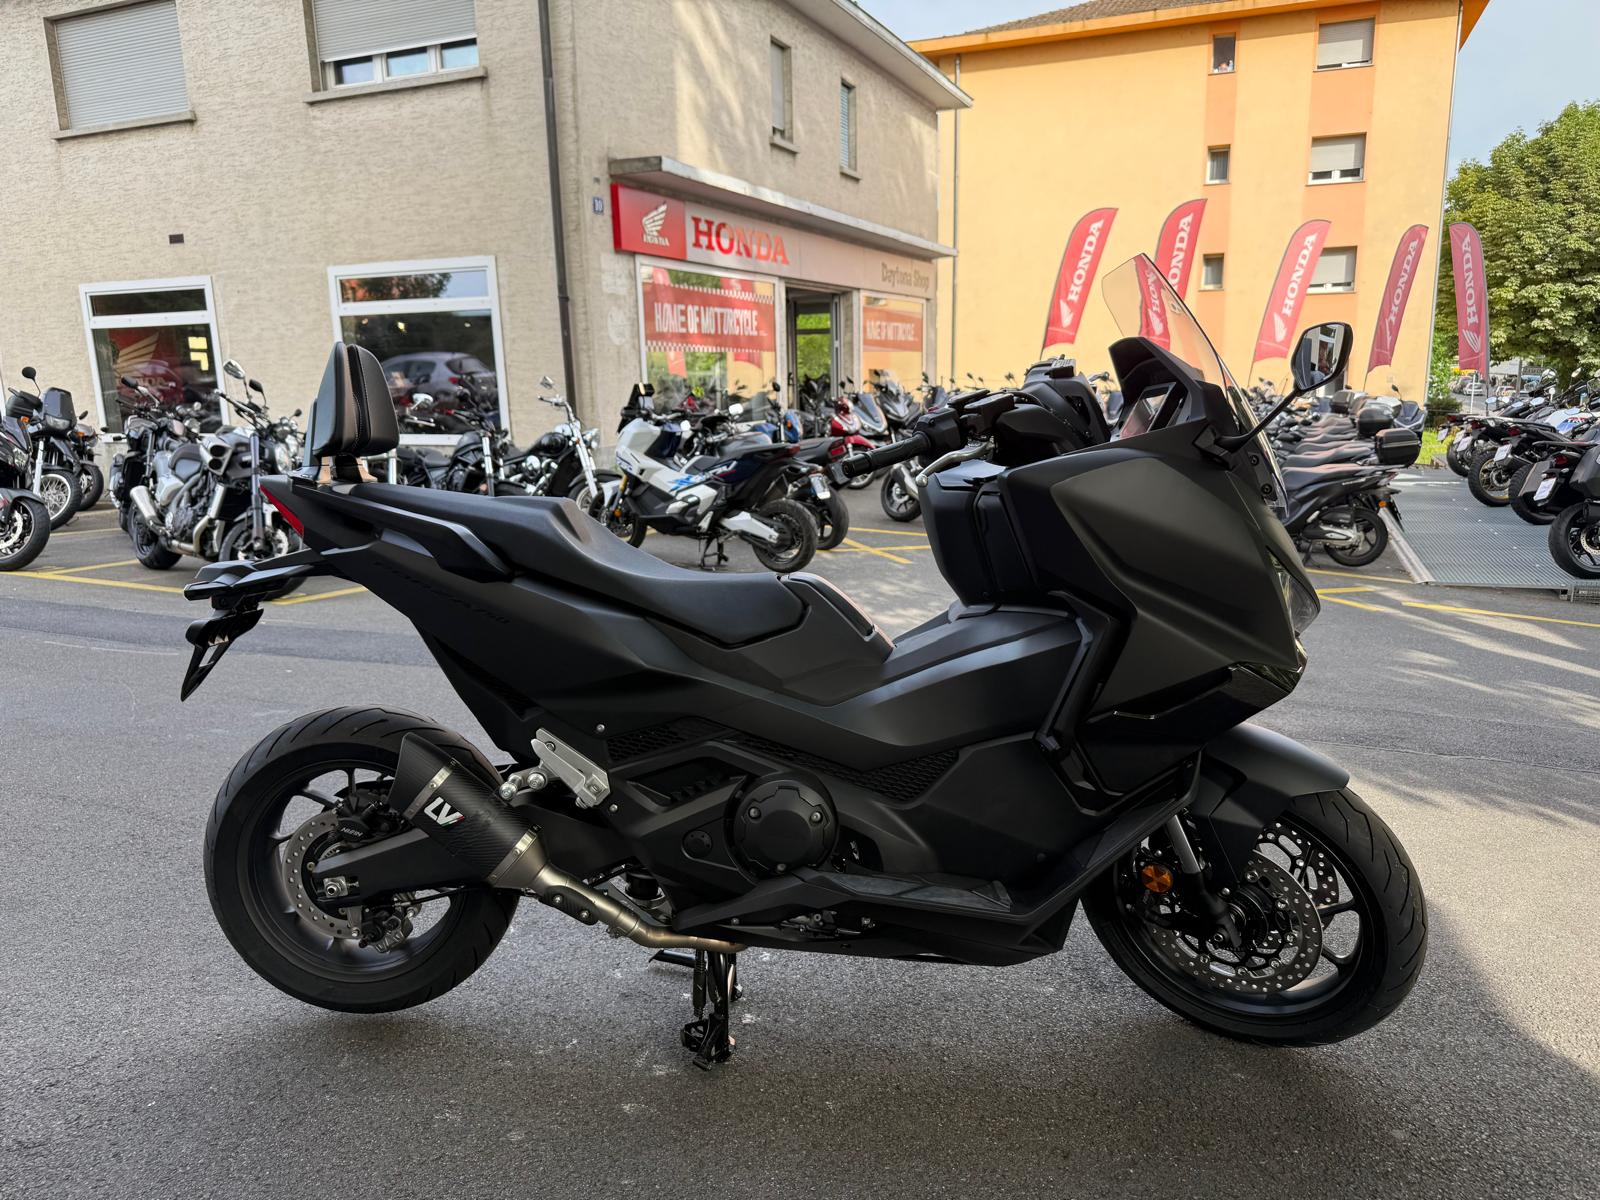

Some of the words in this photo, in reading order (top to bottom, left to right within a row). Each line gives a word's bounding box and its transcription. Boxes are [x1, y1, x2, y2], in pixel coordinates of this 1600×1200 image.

[691, 216, 790, 265] HONDA
[1067, 219, 1105, 303] HONDA
[1281, 232, 1319, 317] HONDA
[1388, 240, 1419, 325] HONDA
[1462, 232, 1479, 326] HONDA
[654, 302, 687, 333] HOME
[687, 304, 700, 334] OF
[423, 796, 465, 827] LV
